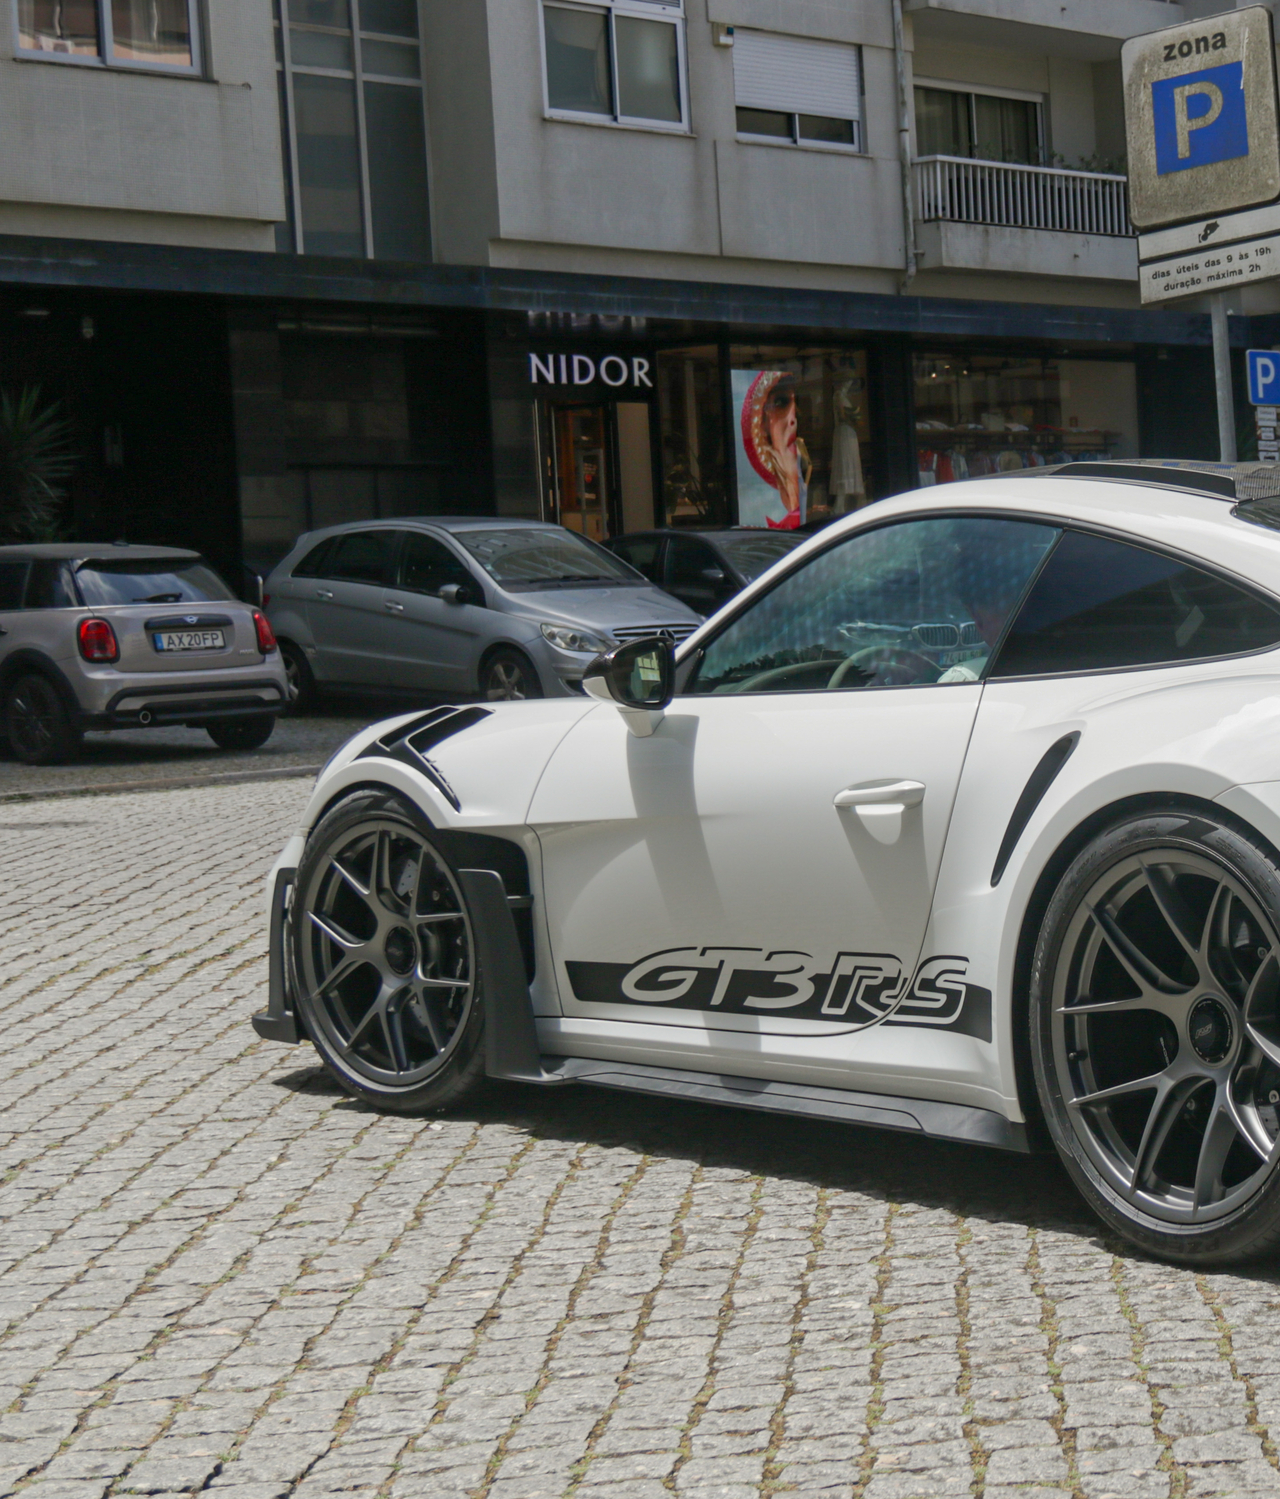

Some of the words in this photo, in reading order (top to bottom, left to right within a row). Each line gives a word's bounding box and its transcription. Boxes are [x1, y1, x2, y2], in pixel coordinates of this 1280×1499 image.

[1163, 32, 1227, 62] zona
[1174, 81, 1224, 159] P
[1152, 269, 1171, 280] dias
[1176, 263, 1199, 275] úteis
[1204, 258, 1221, 268] das
[1226, 254, 1233, 263] 9
[1238, 251, 1249, 261] às
[1255, 246, 1271, 257] 19h
[1164, 278, 1202, 292] duração
[1207, 268, 1243, 282] máxima
[1248, 263, 1261, 274] 2h
[529, 353, 653, 387] NIDOR
[1256, 357, 1275, 398] P
[167, 632, 219, 648] AX20FP
